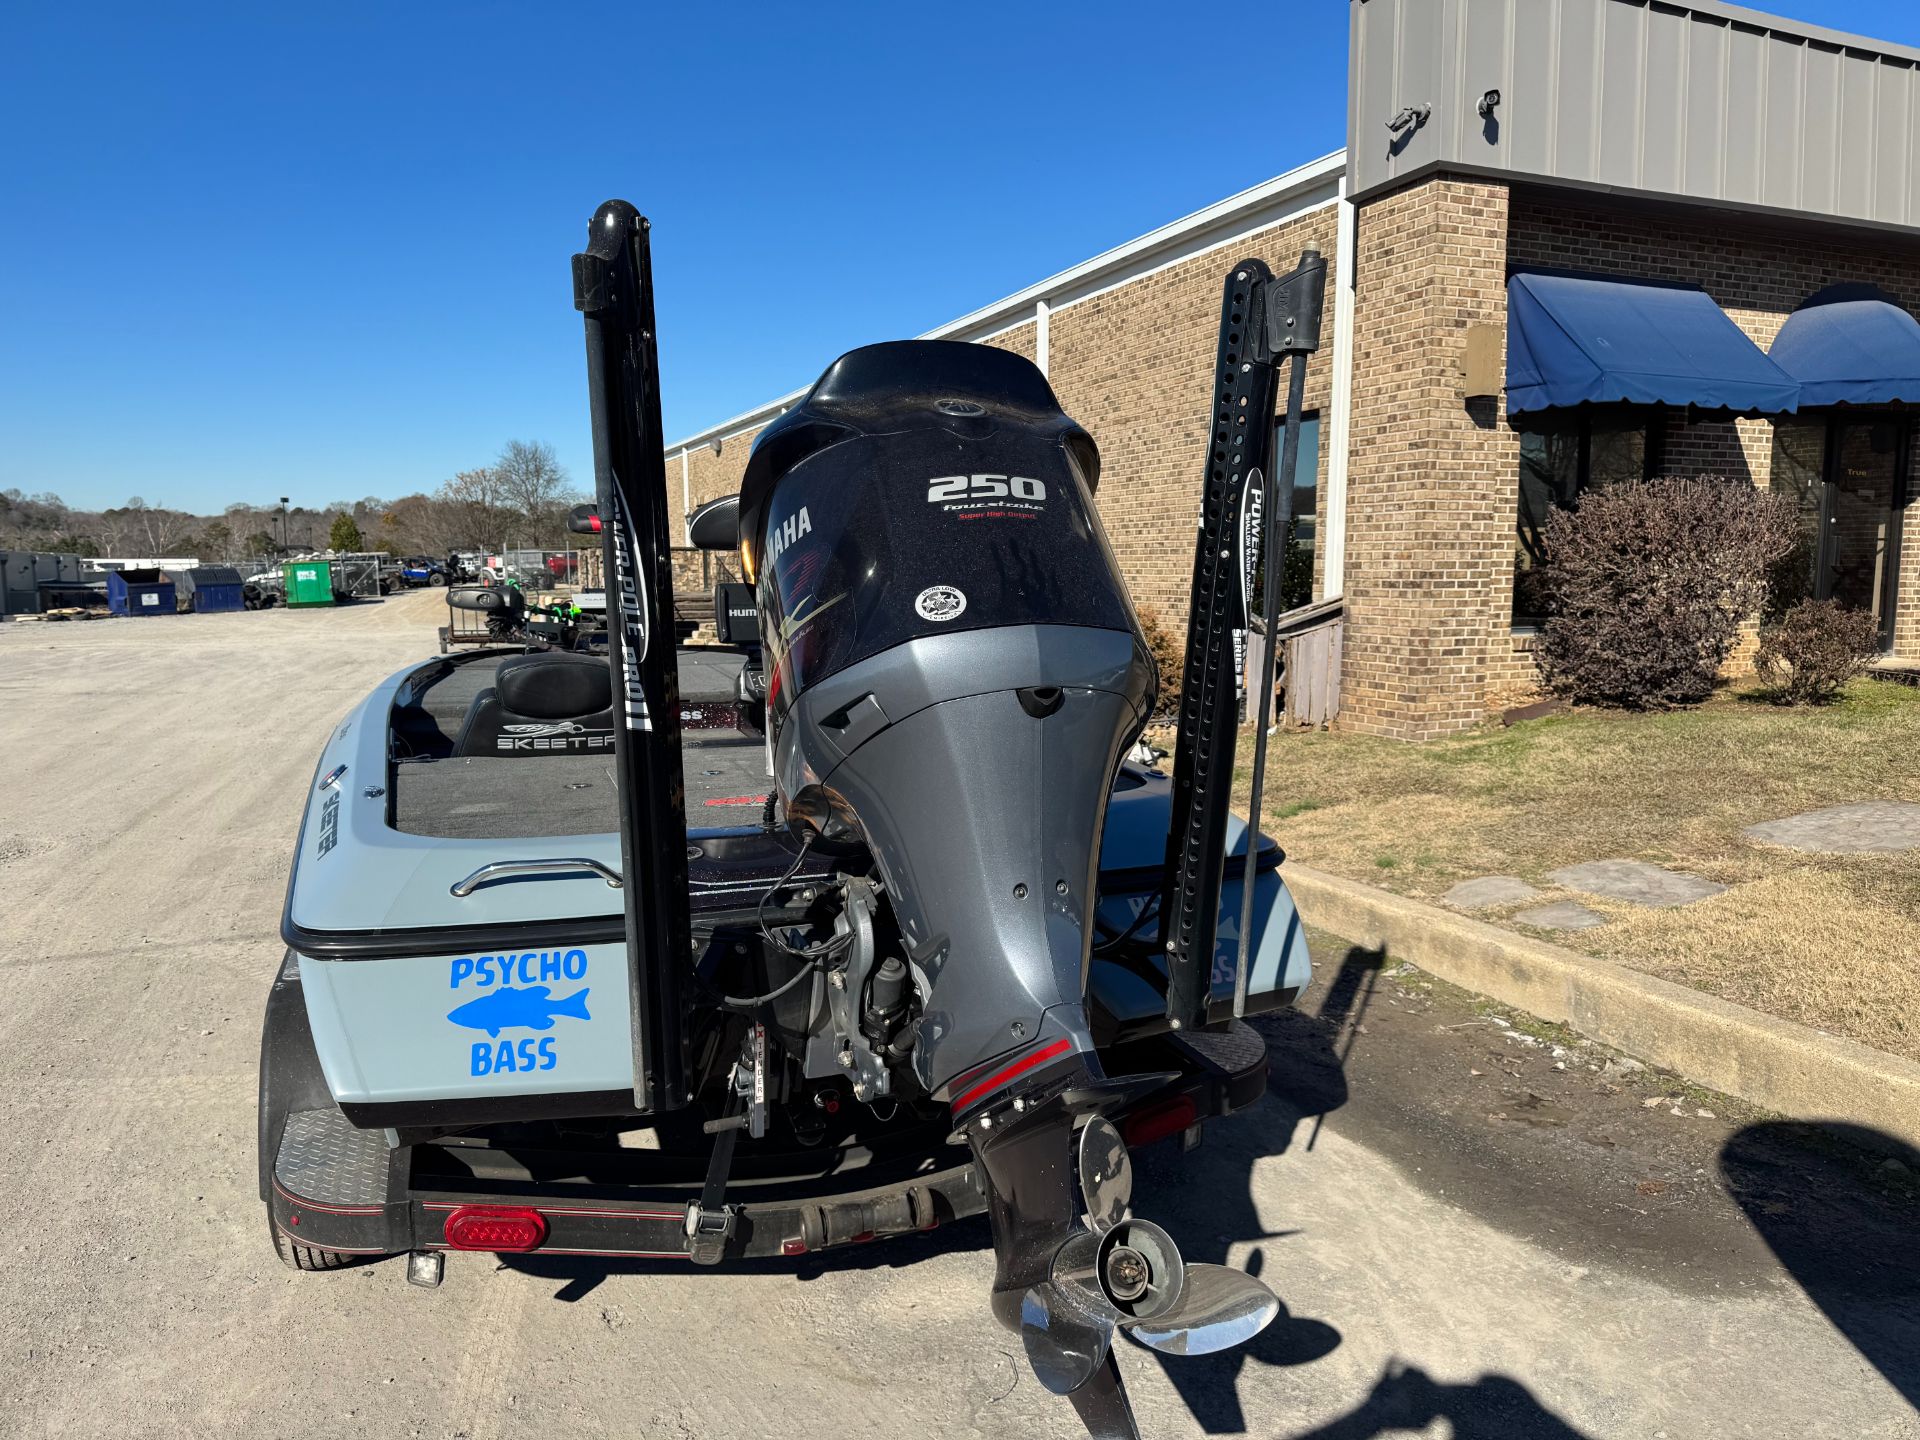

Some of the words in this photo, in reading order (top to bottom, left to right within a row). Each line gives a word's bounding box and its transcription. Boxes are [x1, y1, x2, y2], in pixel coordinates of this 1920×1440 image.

[927, 474, 1046, 502] 250
[450, 949, 588, 989] PSYCHO
[471, 1036, 557, 1077] BASS
